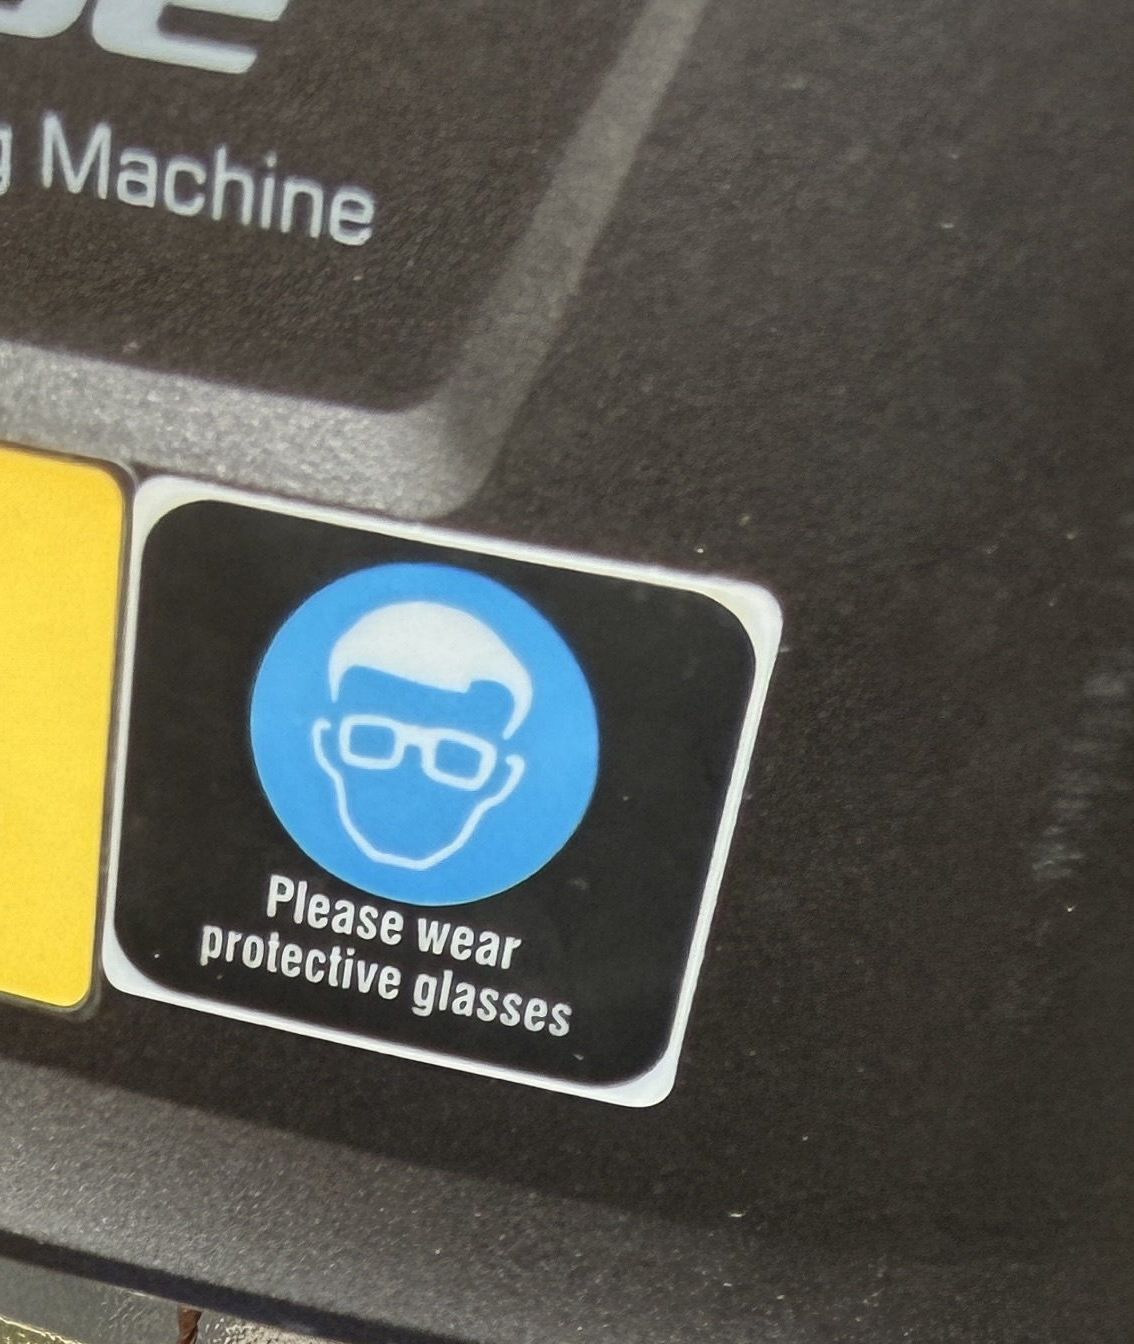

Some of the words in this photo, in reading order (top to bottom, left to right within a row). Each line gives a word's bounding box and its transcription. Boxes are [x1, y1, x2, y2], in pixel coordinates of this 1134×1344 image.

[41, 110, 375, 247] Machine
[266, 873, 405, 947] Please
[417, 916, 522, 971] wear
[198, 924, 403, 1001] protective
[411, 969, 573, 1038] glasses
